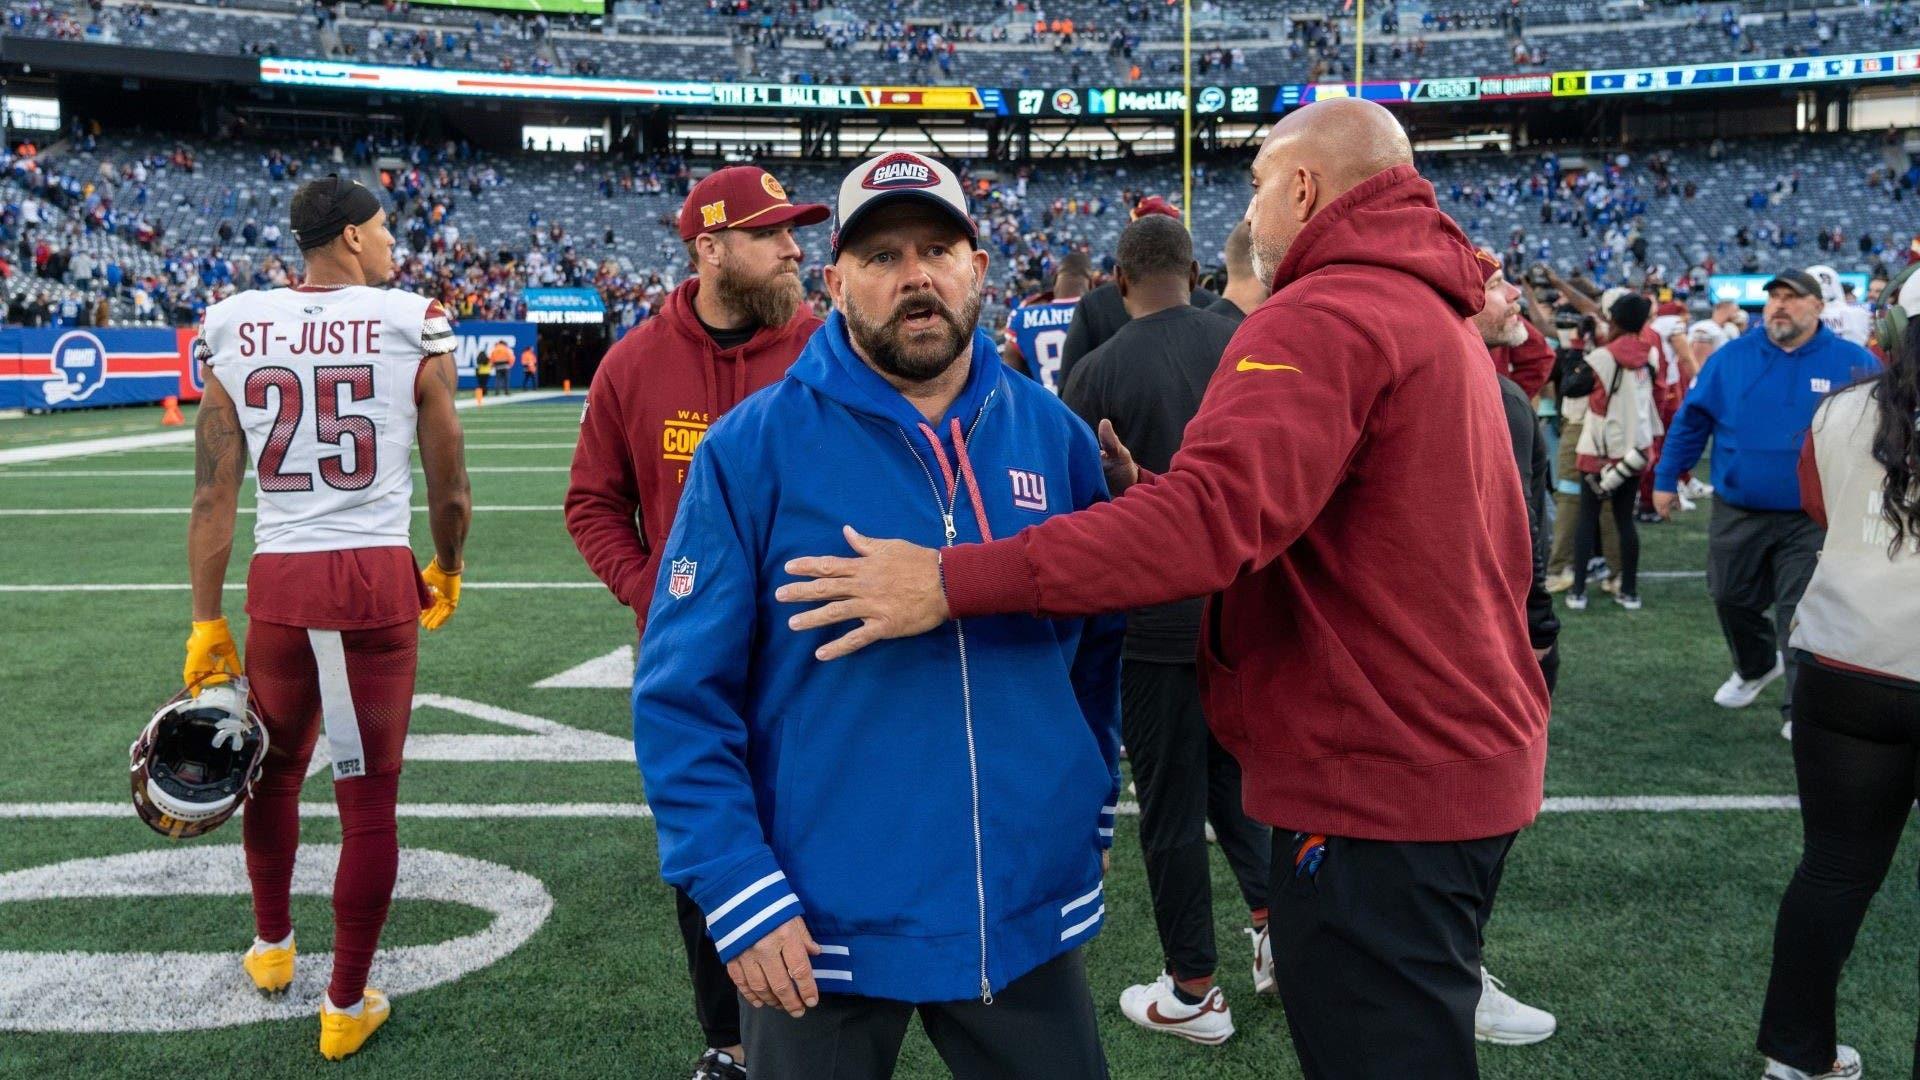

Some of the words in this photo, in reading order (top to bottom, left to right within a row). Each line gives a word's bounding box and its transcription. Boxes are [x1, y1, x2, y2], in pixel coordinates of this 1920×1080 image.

[1018, 89, 1044, 114] 27
[1118, 91, 1188, 110] MetLife
[1231, 87, 1258, 112] 22
[874, 163, 929, 182] GIANTS
[239, 320, 382, 357] ST-JUSTE
[244, 364, 378, 492] 25
[671, 575, 693, 593] NFL
